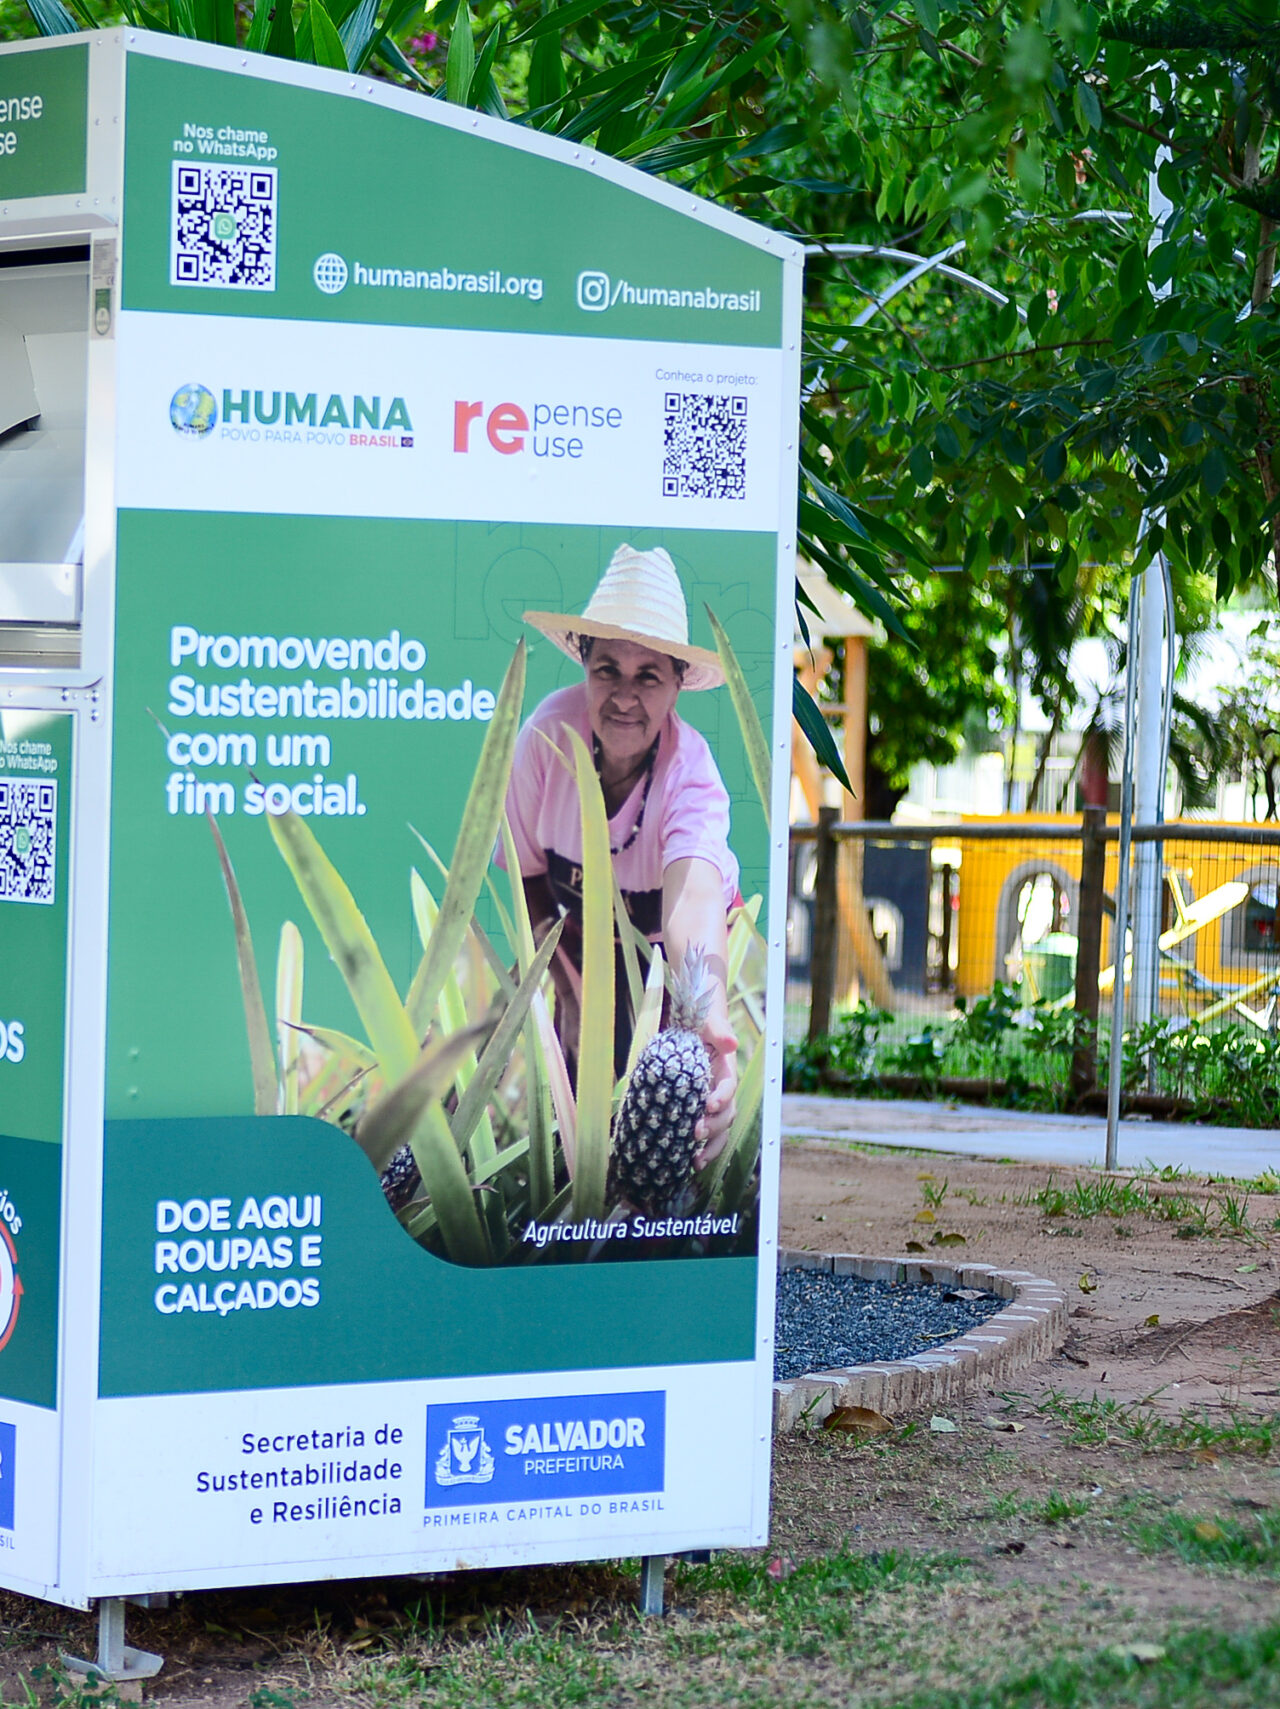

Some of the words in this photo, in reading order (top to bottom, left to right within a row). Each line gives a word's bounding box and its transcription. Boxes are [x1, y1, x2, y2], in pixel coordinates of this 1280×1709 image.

[173, 140, 194, 154] no
[197, 139, 278, 162] WhatsApp
[183, 123, 213, 140] Nos
[216, 126, 268, 144] chame
[353, 262, 544, 302] humanabrasil.org
[610, 280, 762, 313] /humanabrasil
[655, 367, 702, 385] Conheça
[706, 374, 714, 384] o
[716, 370, 759, 390] projeto:
[222, 388, 414, 432] HUMANA
[221, 428, 263, 443] POVO
[266, 430, 300, 445] PARA
[306, 432, 346, 446] POVO
[349, 433, 399, 448] BRASIL
[453, 400, 530, 456] re
[533, 401, 623, 435] pense
[533, 436, 584, 459] use
[170, 626, 427, 672] Promovendo
[168, 675, 496, 721] Sustentabilidade
[0, 739, 17, 756] Nos
[19, 741, 52, 757] chame
[7, 755, 57, 773] WhatsApp
[167, 732, 257, 767] com
[267, 732, 331, 767] um
[166, 773, 236, 816] fim
[244, 775, 367, 817] social.
[155, 1198, 230, 1234] DOE
[237, 1196, 321, 1231] AQUI
[523, 1217, 628, 1244] Agricultura
[632, 1212, 738, 1239] Sustentável
[155, 1237, 292, 1274] ROUPAS
[300, 1235, 321, 1267] E
[155, 1277, 320, 1317] CALÇADOS
[241, 1425, 365, 1456] Secretaria
[375, 1422, 404, 1446] de
[504, 1418, 646, 1457] SALVADOR
[196, 1459, 403, 1494] Sustentabilidade
[524, 1454, 625, 1476] PREFEITURA
[249, 1508, 262, 1525] e
[273, 1493, 402, 1524] Resiliência
[423, 1510, 500, 1528] PRIMEIRA
[507, 1505, 573, 1522] CAPITAL
[580, 1503, 602, 1517] DO
[609, 1498, 665, 1514] BRASIL
